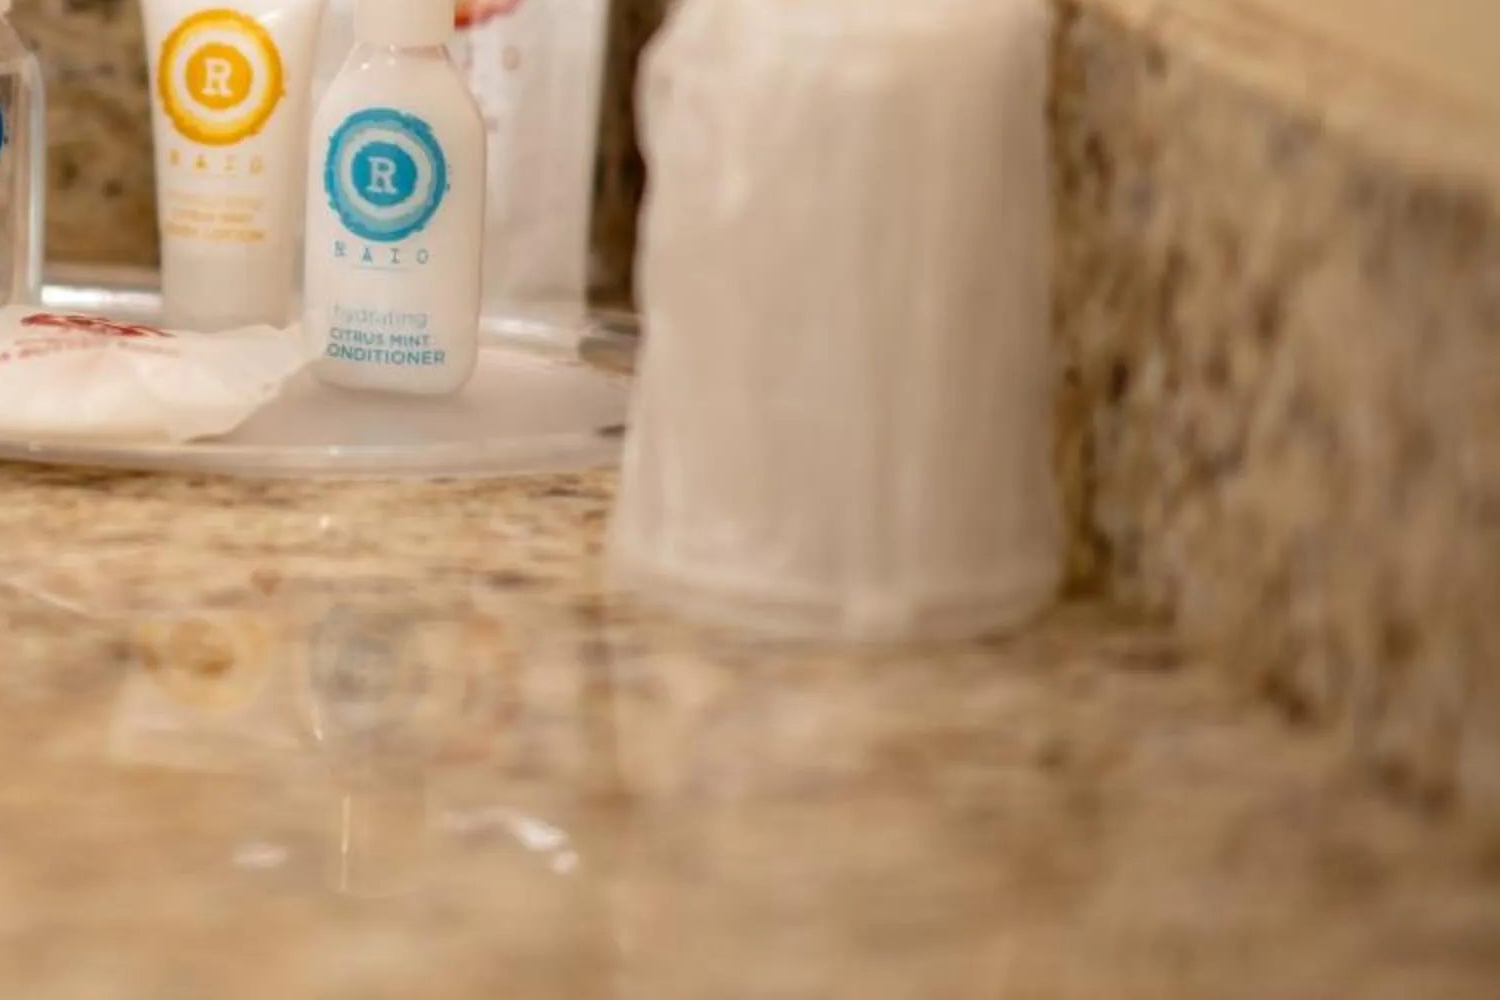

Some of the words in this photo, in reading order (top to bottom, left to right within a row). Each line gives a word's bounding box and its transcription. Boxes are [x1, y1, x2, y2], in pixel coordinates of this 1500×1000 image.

[201, 58, 232, 97] R
[366, 156, 398, 193] R
[333, 240, 430, 265] RAIO
[330, 327, 385, 345] CITRUS
[389, 333, 431, 348] MINT
[327, 343, 446, 366] ONDITIONER
